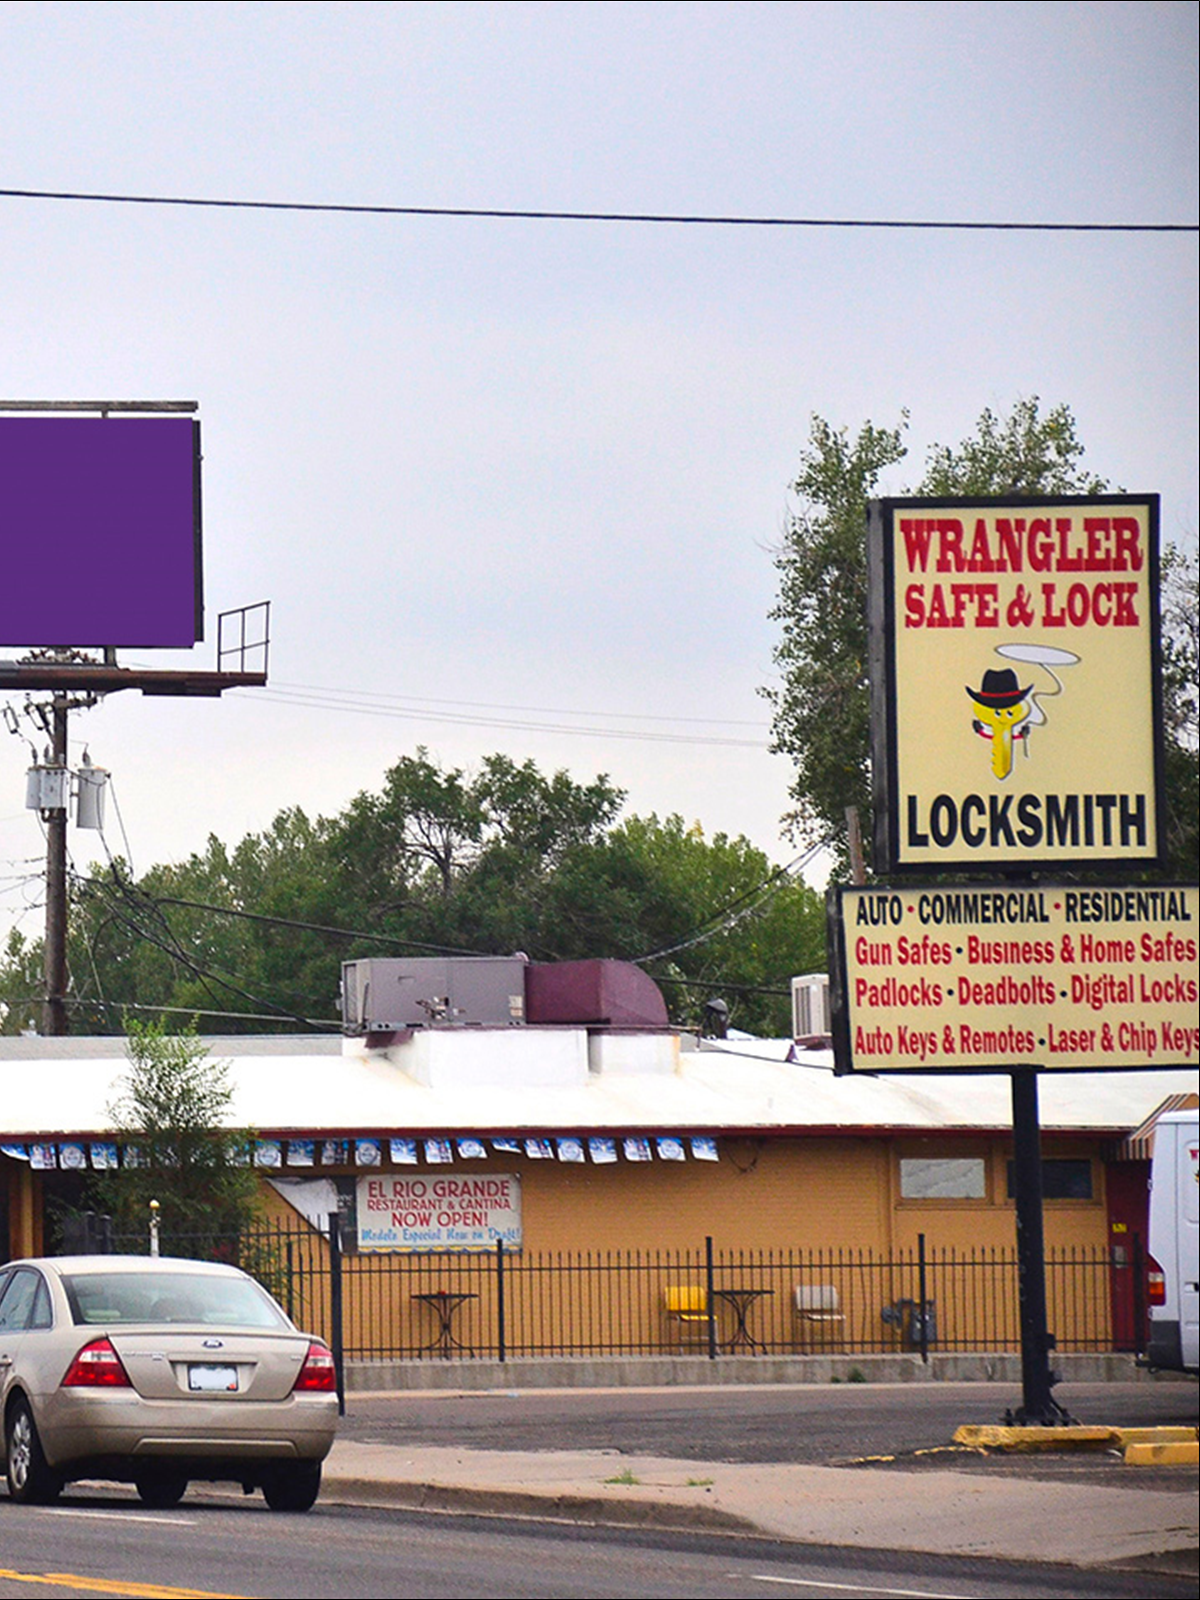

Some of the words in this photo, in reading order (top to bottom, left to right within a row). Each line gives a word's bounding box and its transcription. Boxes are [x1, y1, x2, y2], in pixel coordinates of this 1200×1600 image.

[900, 516, 1143, 573] WRANGLER
[904, 583, 999, 629] SAFE
[1006, 584, 1034, 628] &
[1041, 581, 1139, 627] LOCK
[907, 793, 1147, 848] LOCKSMITH
[856, 894, 903, 926] AUTO
[918, 893, 1050, 925] COMMERCIAL
[1065, 891, 1191, 923] RESIDENTIAL
[855, 935, 892, 966] Gun
[897, 934, 953, 966] Safes
[968, 935, 1055, 965] Business
[1060, 933, 1075, 964] &
[1080, 933, 1136, 963] Home
[1140, 931, 1197, 963] Safes
[855, 976, 943, 1007] Padlocks
[958, 975, 1056, 1005] Deadbolts
[1071, 973, 1135, 1011] Digital
[1140, 972, 1198, 1003] Locks
[855, 1025, 894, 1055] Auto
[898, 1025, 938, 1062] Keys
[942, 1024, 956, 1054] &
[960, 1024, 1035, 1054] Remotes
[1048, 1023, 1096, 1053] Laser
[1101, 1022, 1114, 1052] &
[1118, 1021, 1157, 1058] Chip
[1161, 1021, 1199, 1058] Keys
[367, 1199, 443, 1211] RESTAURANT
[448, 1200, 455, 1210] &
[459, 1199, 511, 1210] CANTINA
[368, 1181, 387, 1198] EL
[393, 1180, 427, 1198] RIO
[433, 1180, 511, 1198] GRANDE
[361, 1229, 397, 1241] Modelo
[403, 1228, 441, 1242] Especial
[447, 1229, 468, 1240] Now
[472, 1232, 484, 1240] on
[391, 1211, 432, 1228] NOW
[437, 1211, 489, 1227] OPEN!
